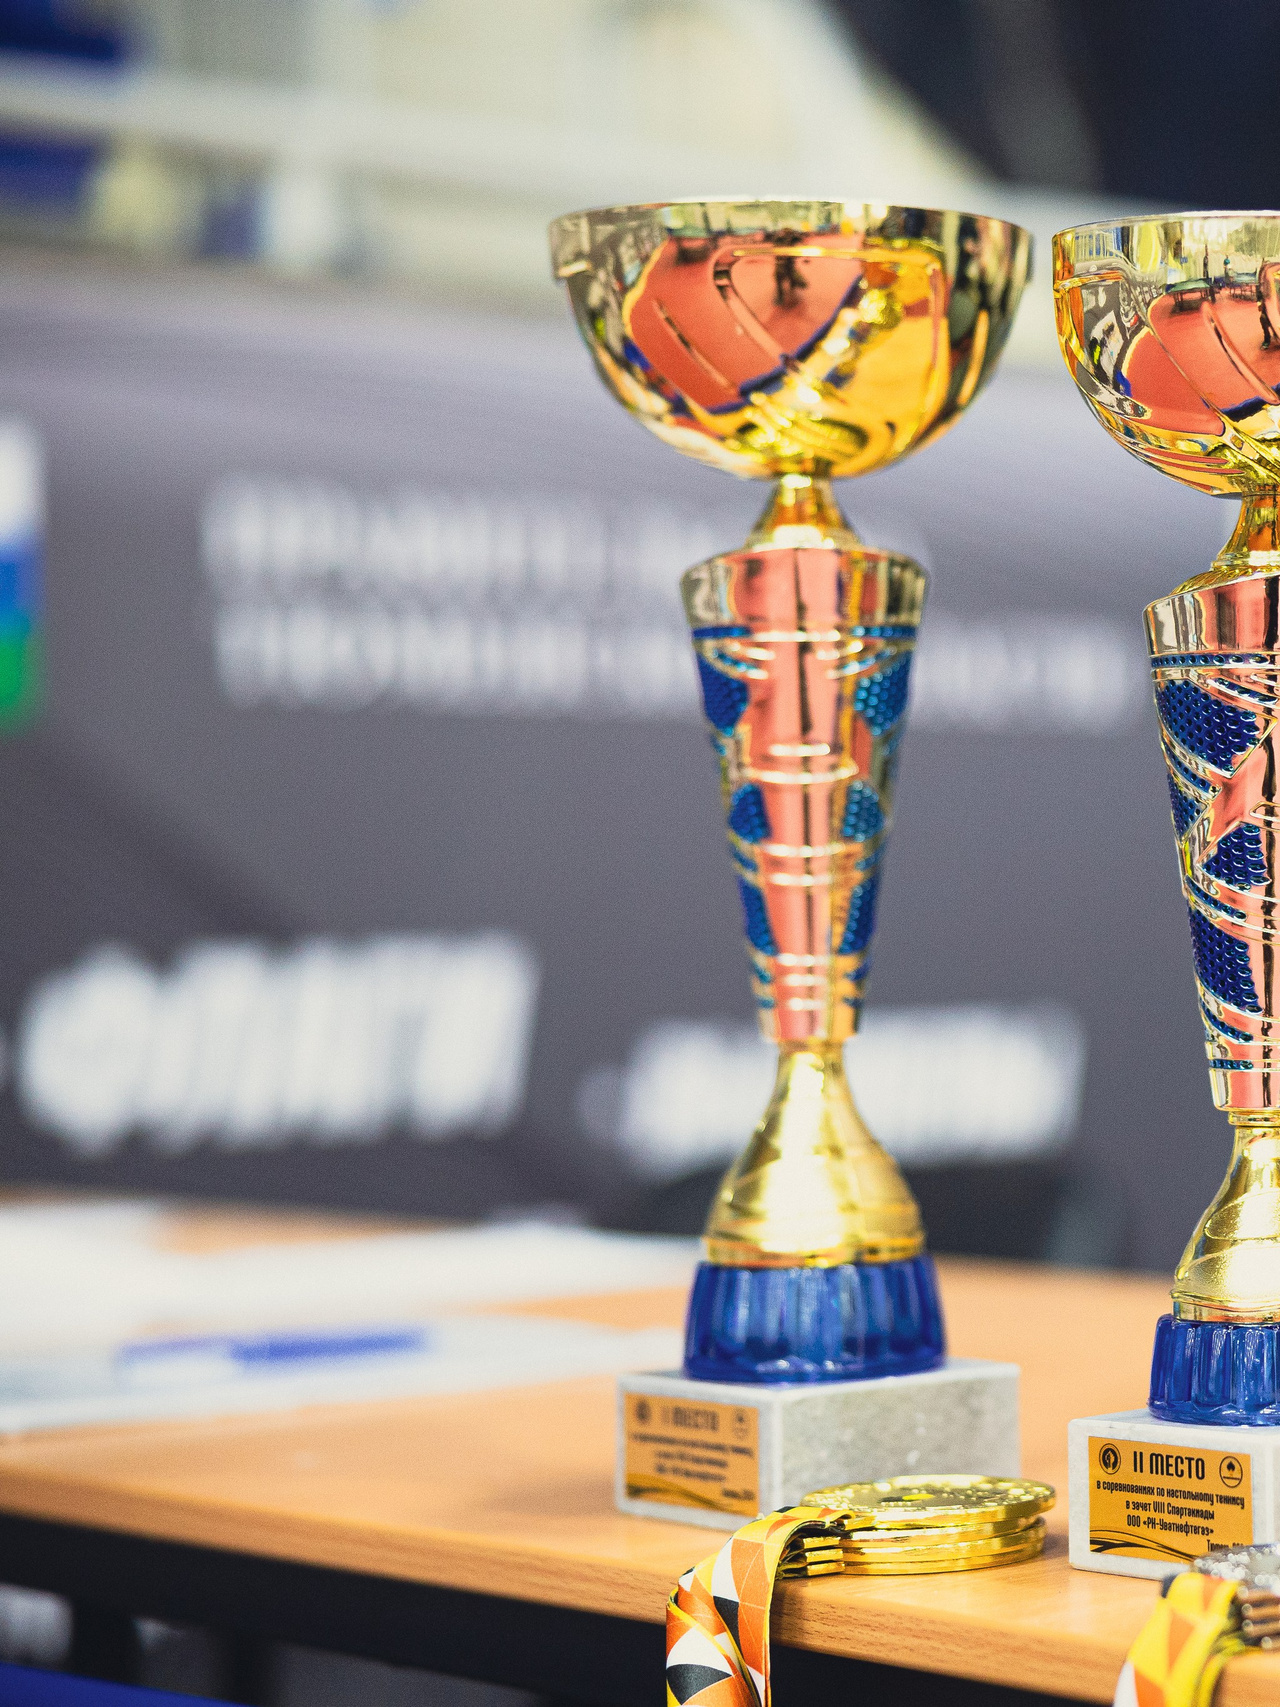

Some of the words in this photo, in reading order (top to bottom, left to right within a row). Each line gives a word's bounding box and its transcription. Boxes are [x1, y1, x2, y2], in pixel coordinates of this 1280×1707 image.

[1133, 1450, 1144, 1474] II
[1149, 1452, 1206, 1480] МЕСТО
[1096, 1480, 1102, 1490] в
[1102, 1481, 1155, 1496] соревнованиях
[1156, 1486, 1166, 1497] по
[1166, 1488, 1214, 1506] настольному
[1215, 1493, 1245, 1510] теннису
[1125, 1500, 1131, 1510] в
[1131, 1501, 1152, 1512] зачет
[1152, 1501, 1166, 1514] VIII
[1166, 1503, 1215, 1521] Спартакиады
[1126, 1514, 1141, 1528] ООО
[1142, 1516, 1214, 1537] «РН-Уватнефтегаз»
